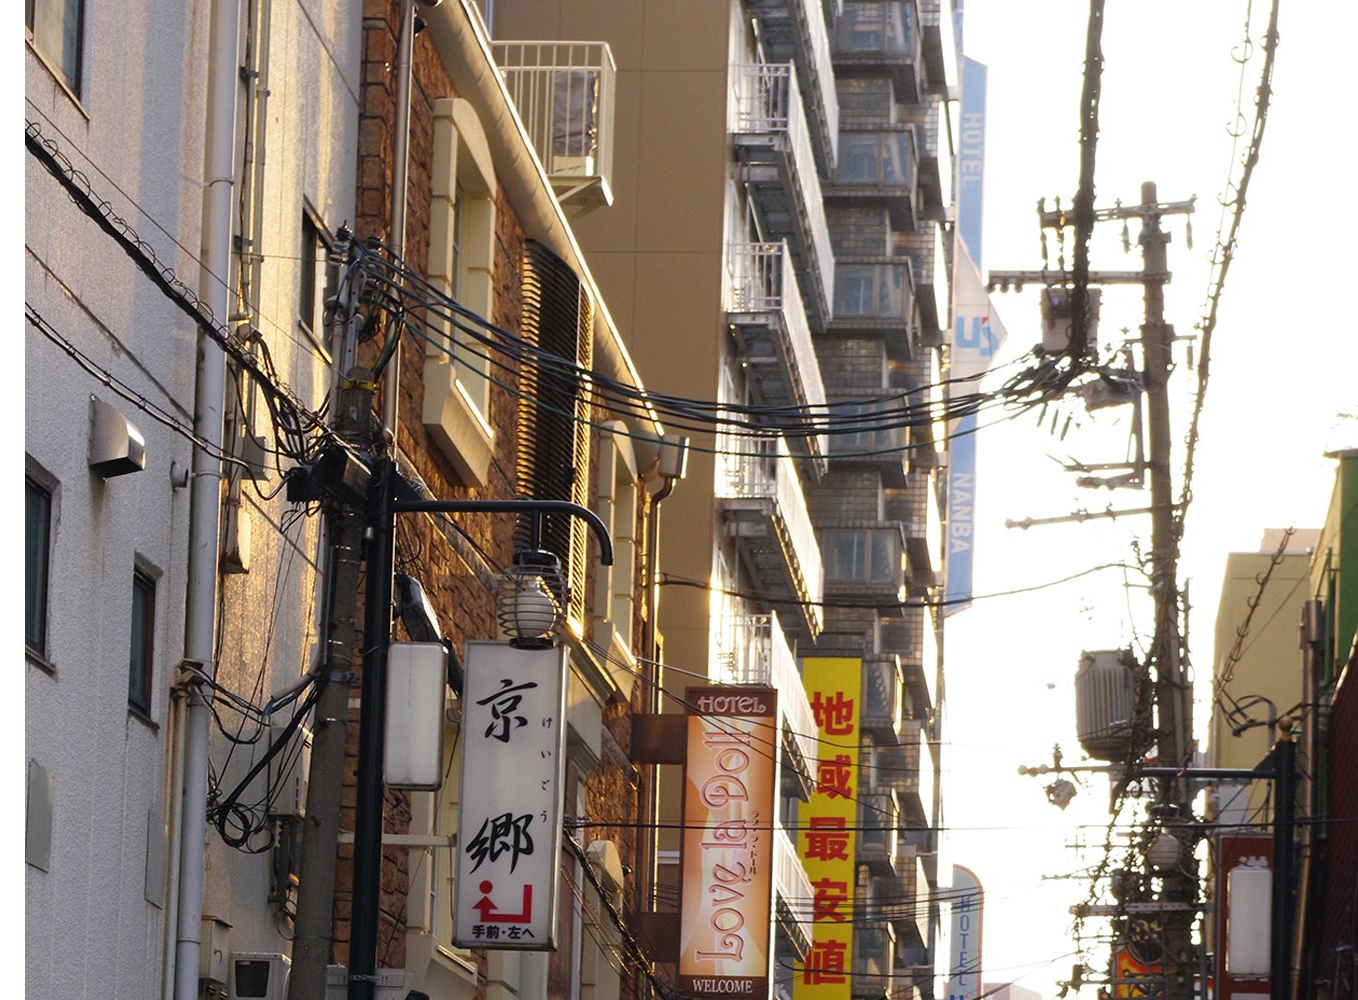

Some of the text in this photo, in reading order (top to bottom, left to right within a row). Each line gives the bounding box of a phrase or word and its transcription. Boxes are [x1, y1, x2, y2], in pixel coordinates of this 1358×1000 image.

[960, 112, 985, 188] HOTEL
[949, 471, 974, 556] NANBA
[697, 696, 767, 714] HOTEL
[466, 679, 539, 876] 京郷
[804, 691, 855, 987] 地域最安値
[471, 925, 536, 940] 手前・左へ
[958, 895, 971, 987] HOTEL
[692, 979, 753, 994] WELCOME
